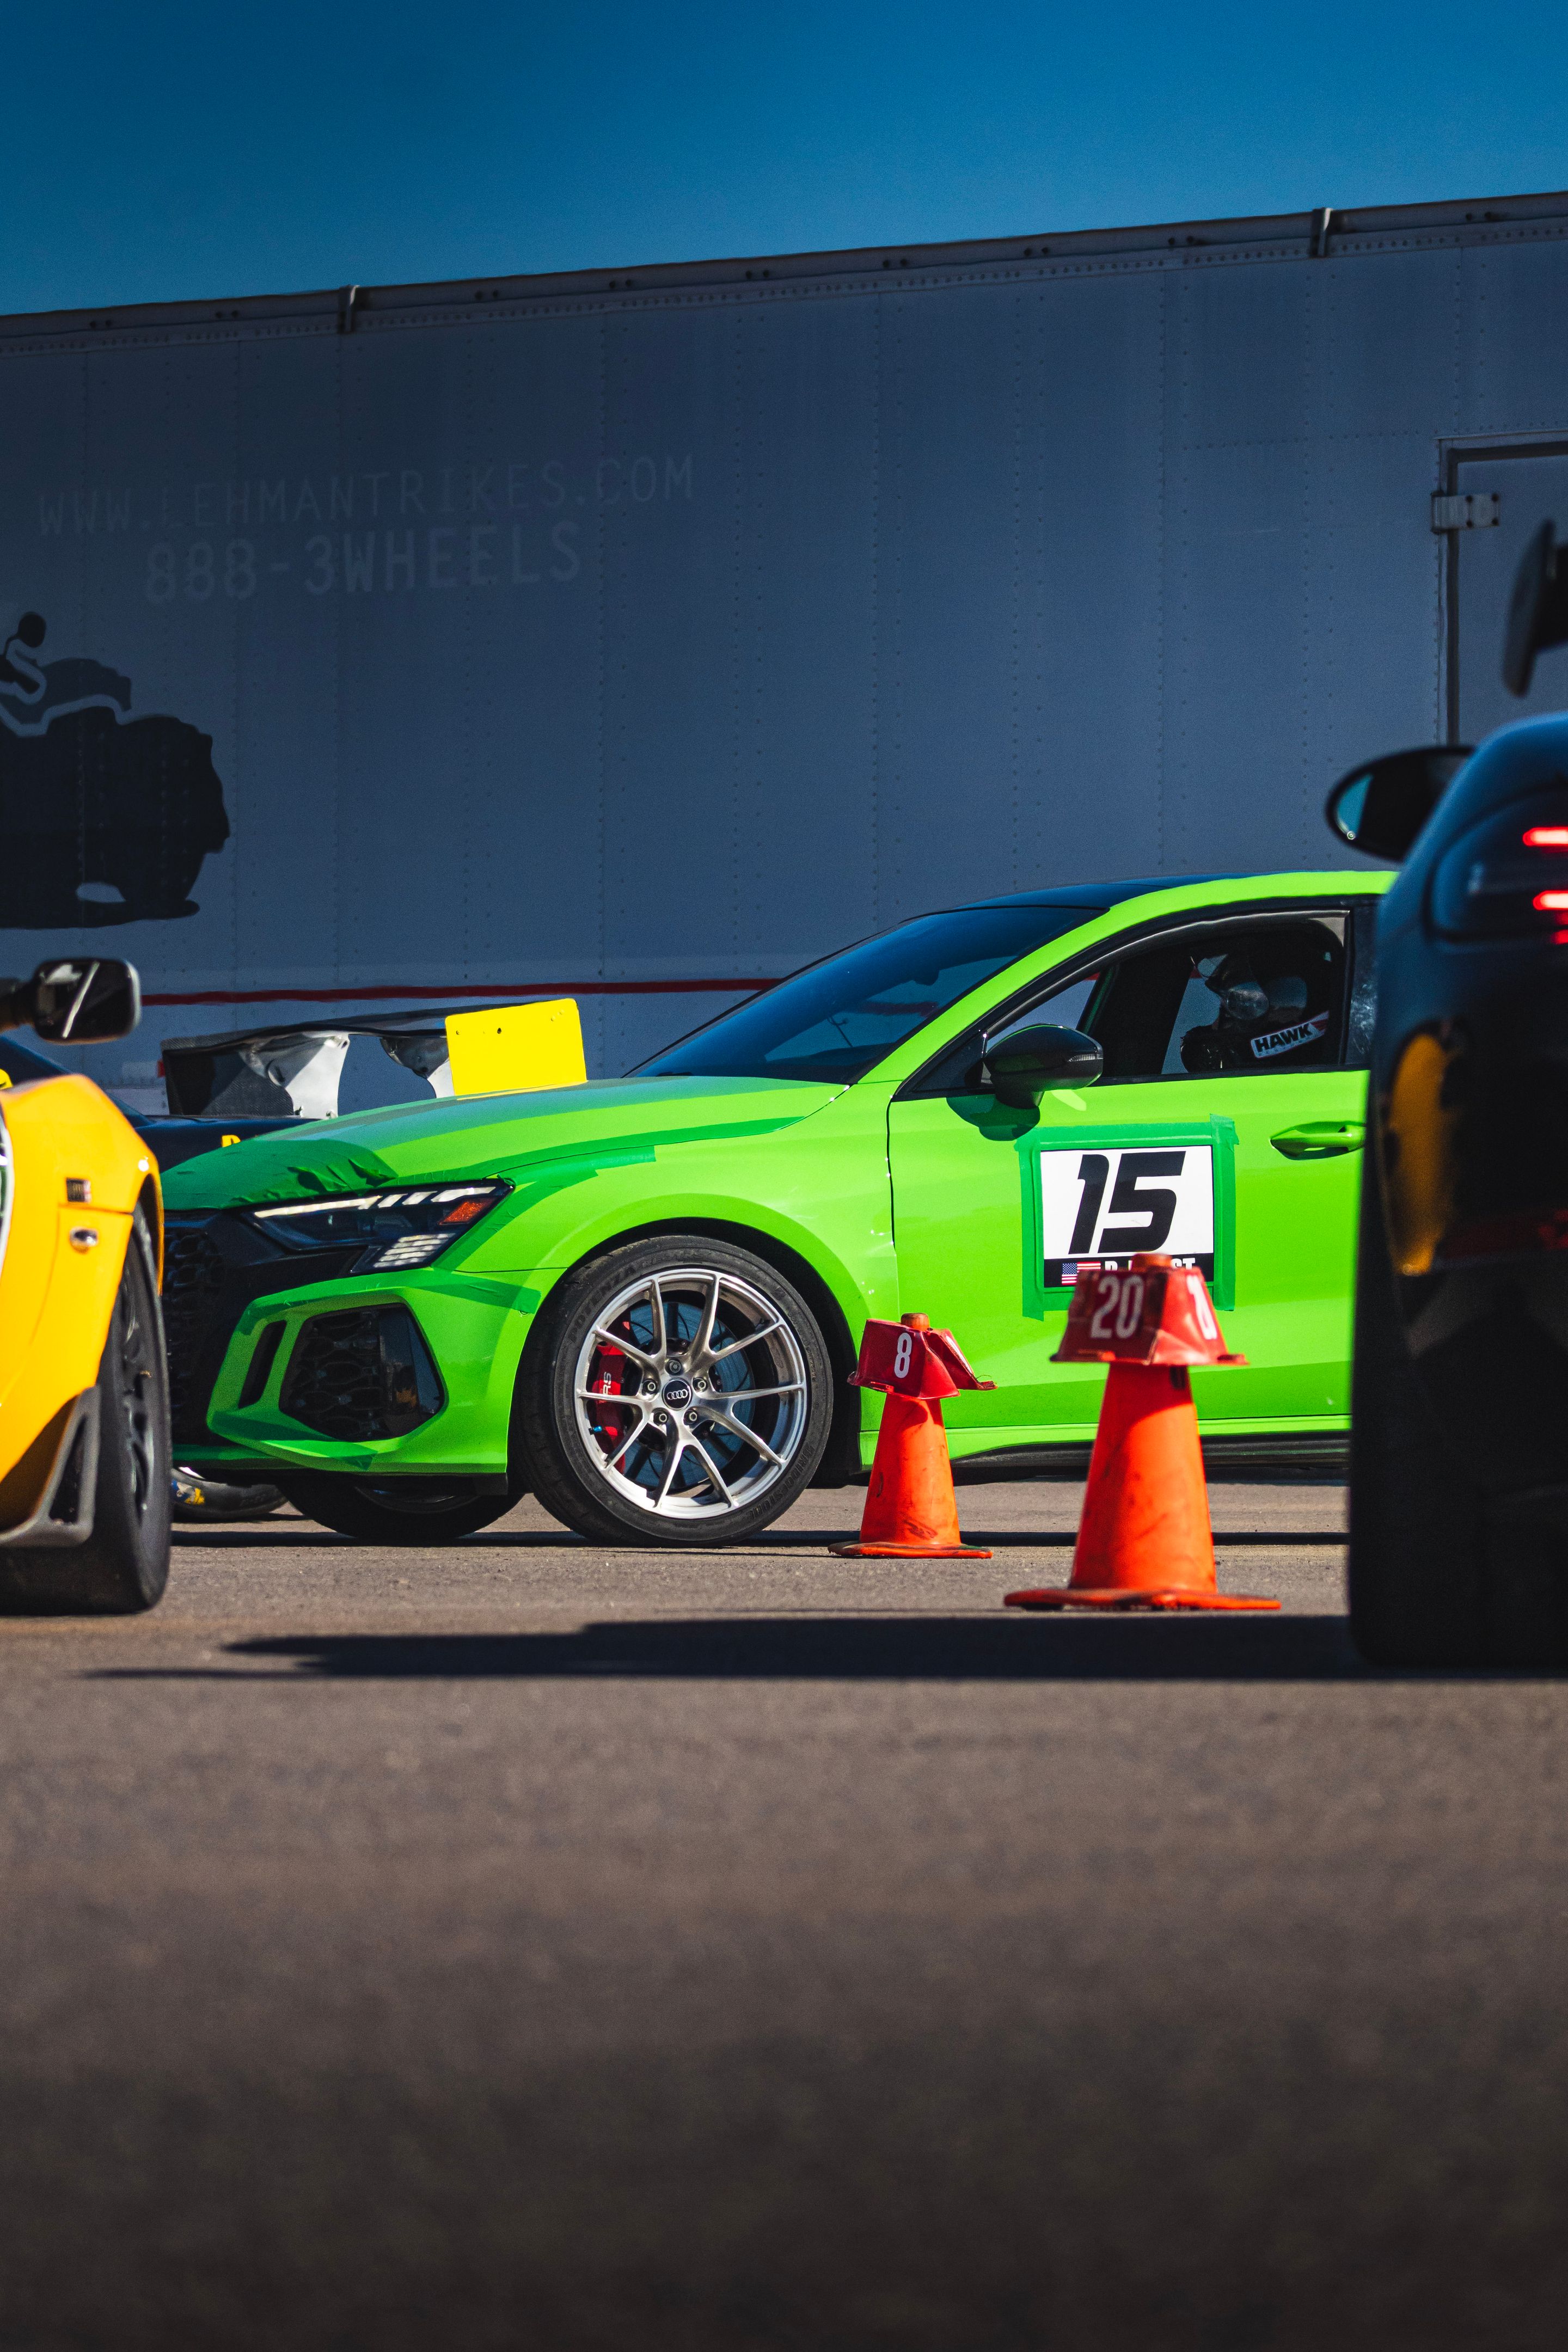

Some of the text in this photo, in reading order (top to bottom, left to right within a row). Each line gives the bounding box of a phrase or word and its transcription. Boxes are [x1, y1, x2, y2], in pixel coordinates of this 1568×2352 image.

[39, 455, 693, 536] WWW.LEHMANTRIKES.COM
[144, 520, 580, 604] 888-3WHEELS
[1254, 1023, 1313, 1052] HAWK
[1068, 1151, 1186, 1254] 15
[568, 1266, 636, 1342] POTENZA
[1090, 1274, 1144, 1339] 20
[603, 1371, 611, 1395] RS
[894, 1332, 912, 1378] 8
[748, 1443, 816, 1520] BRIDGESTONE
